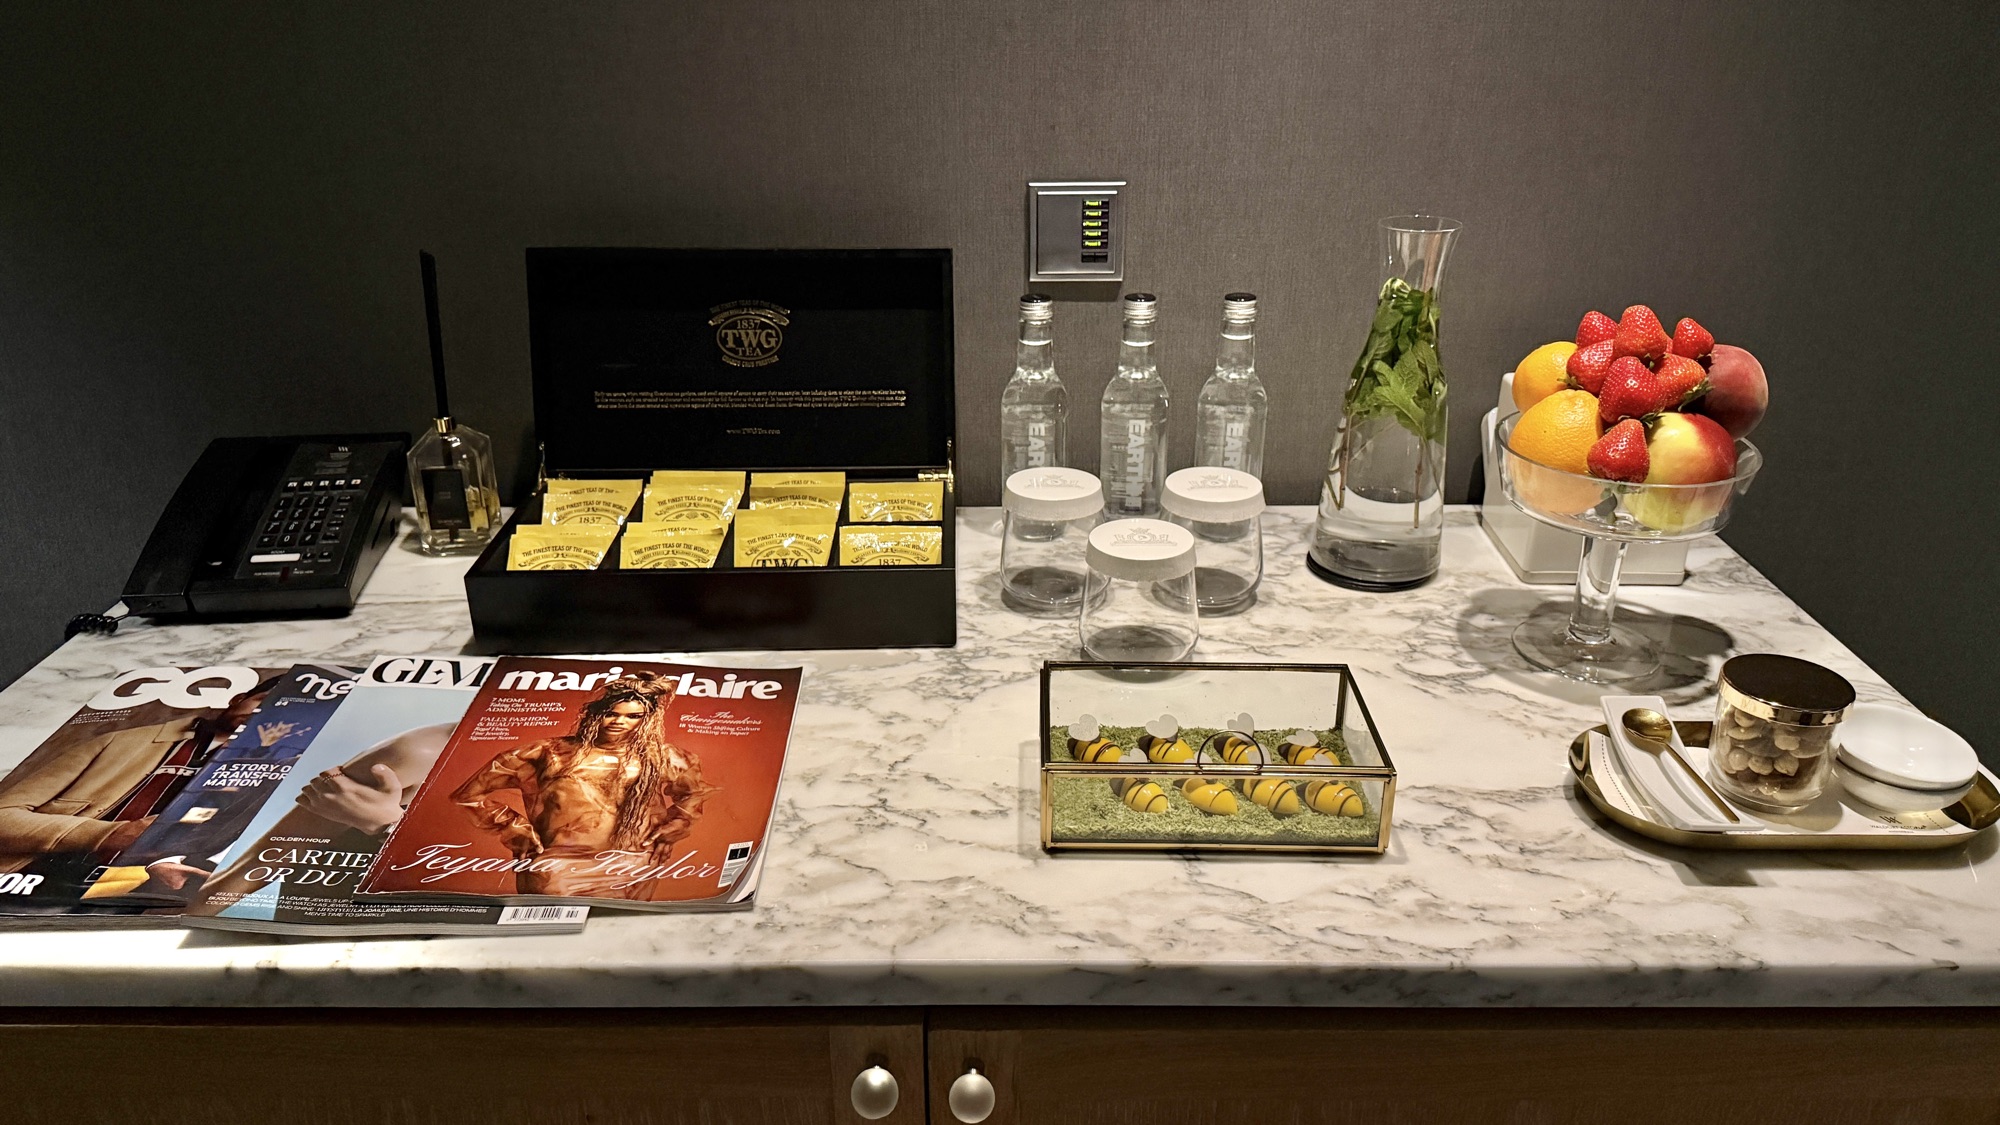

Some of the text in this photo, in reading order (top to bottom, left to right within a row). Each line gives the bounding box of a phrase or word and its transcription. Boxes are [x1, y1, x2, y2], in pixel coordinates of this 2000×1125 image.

[736, 319, 761, 329] 1837
[721, 329, 778, 349] TWG
[736, 347, 762, 356] TEA
[1028, 422, 1046, 467] EAR
[1223, 422, 1244, 468] EAR
[566, 502, 583, 510] FINEST
[612, 503, 627, 512] WORLD
[579, 516, 601, 524] 1837
[757, 534, 773, 542] FINEST
[533, 546, 551, 555] FINEST
[644, 544, 661, 552] FINEST
[693, 545, 710, 555] WORLD
[878, 558, 901, 566] 1837
[497, 666, 637, 692] mari
[86, 666, 260, 710] GQ
[295, 673, 363, 700] ne
[680, 712, 763, 726] Changemakers
[709, 711, 735, 719] The
[694, 728, 720, 736] Making
[215, 763, 293, 774] A STORY O
[202, 779, 263, 788] MATION
[258, 847, 377, 868] CARTIE
[391, 842, 721, 890] Teyana Taylor
[244, 866, 295, 883] OR
[293, 868, 353, 887] DU
[0, 872, 45, 896] OR
